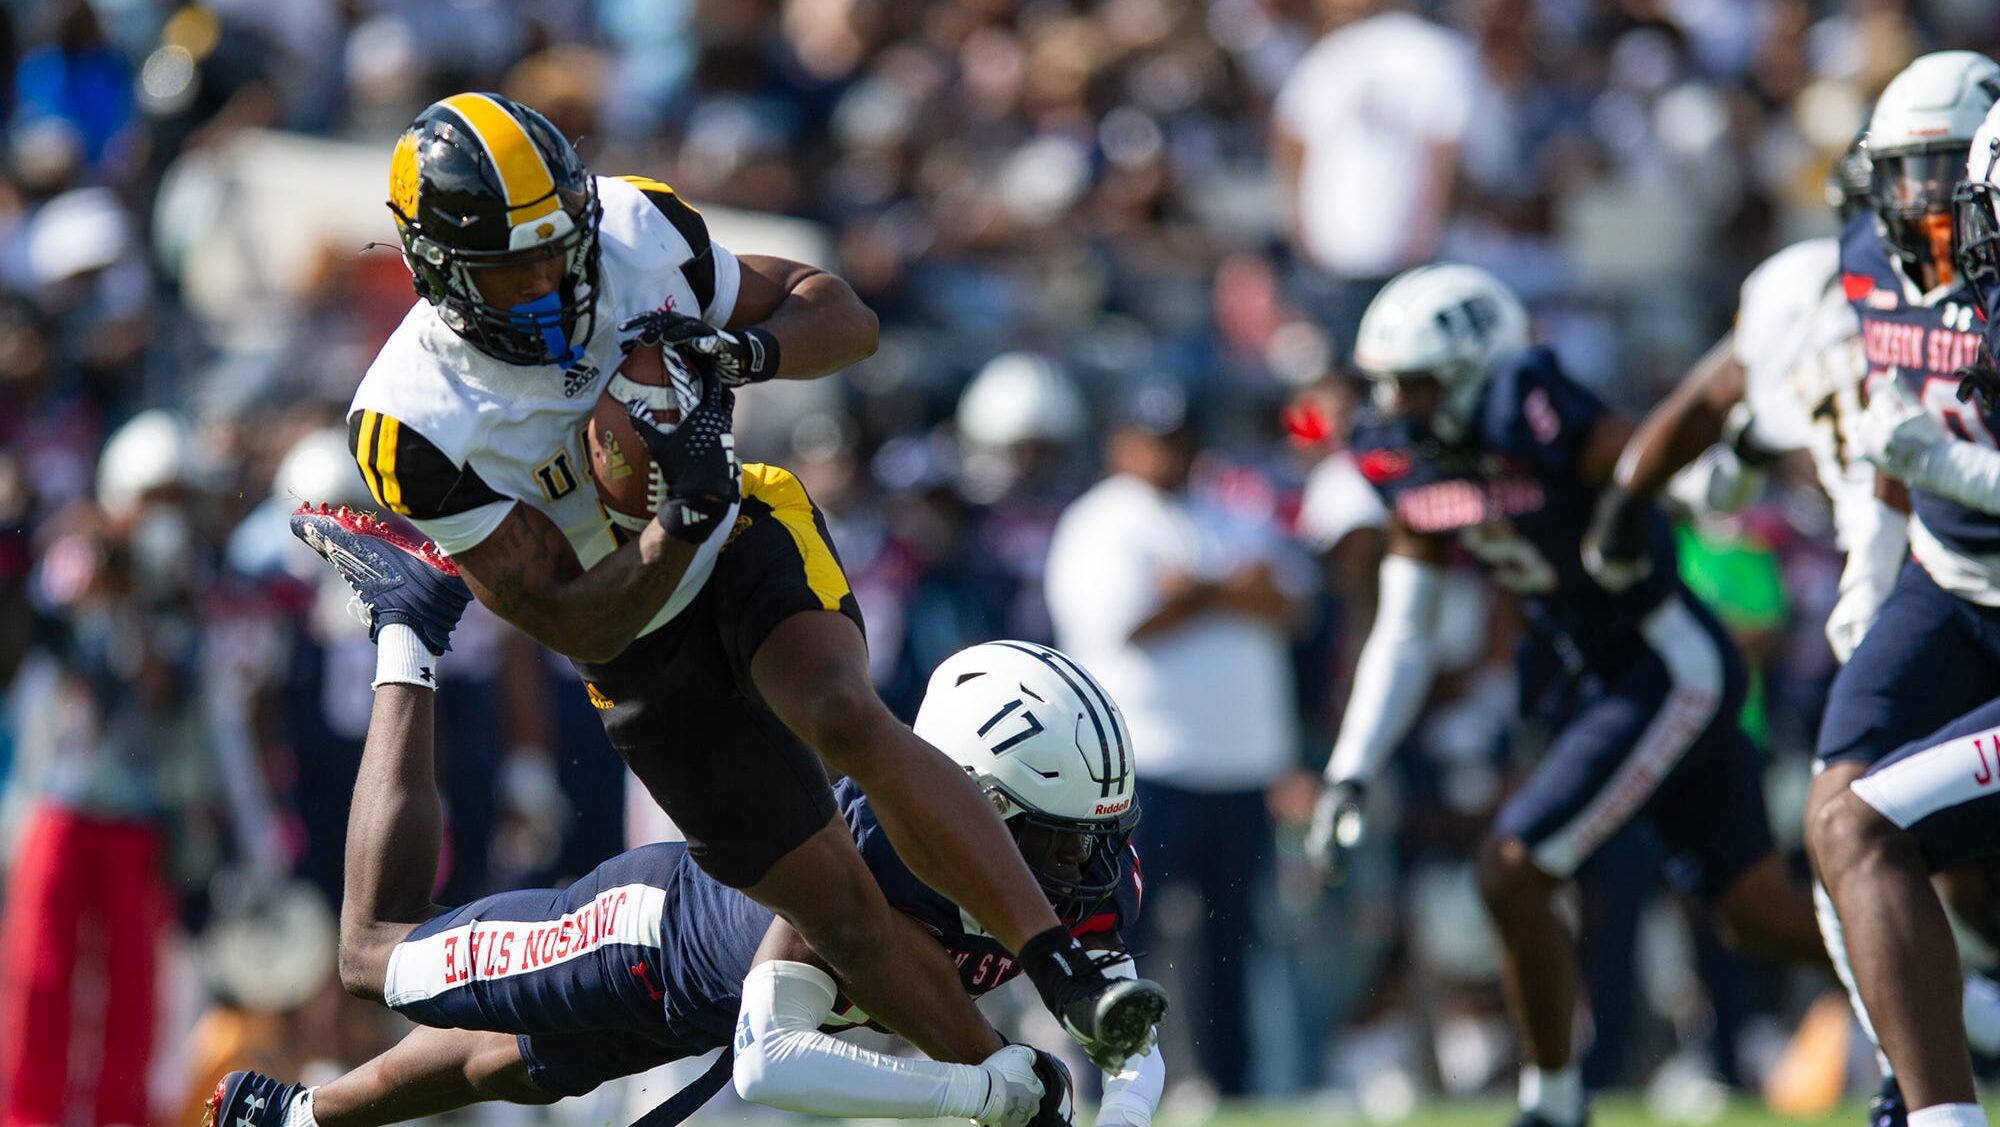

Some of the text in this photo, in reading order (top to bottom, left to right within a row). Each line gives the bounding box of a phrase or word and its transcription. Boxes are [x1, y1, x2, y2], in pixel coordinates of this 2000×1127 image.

[571, 237, 593, 275] Ridde
[564, 366, 600, 398] adidas
[977, 699, 1045, 756] 17
[1095, 799, 1130, 815] Riddell
[444, 892, 627, 984] JACKSON STAE
